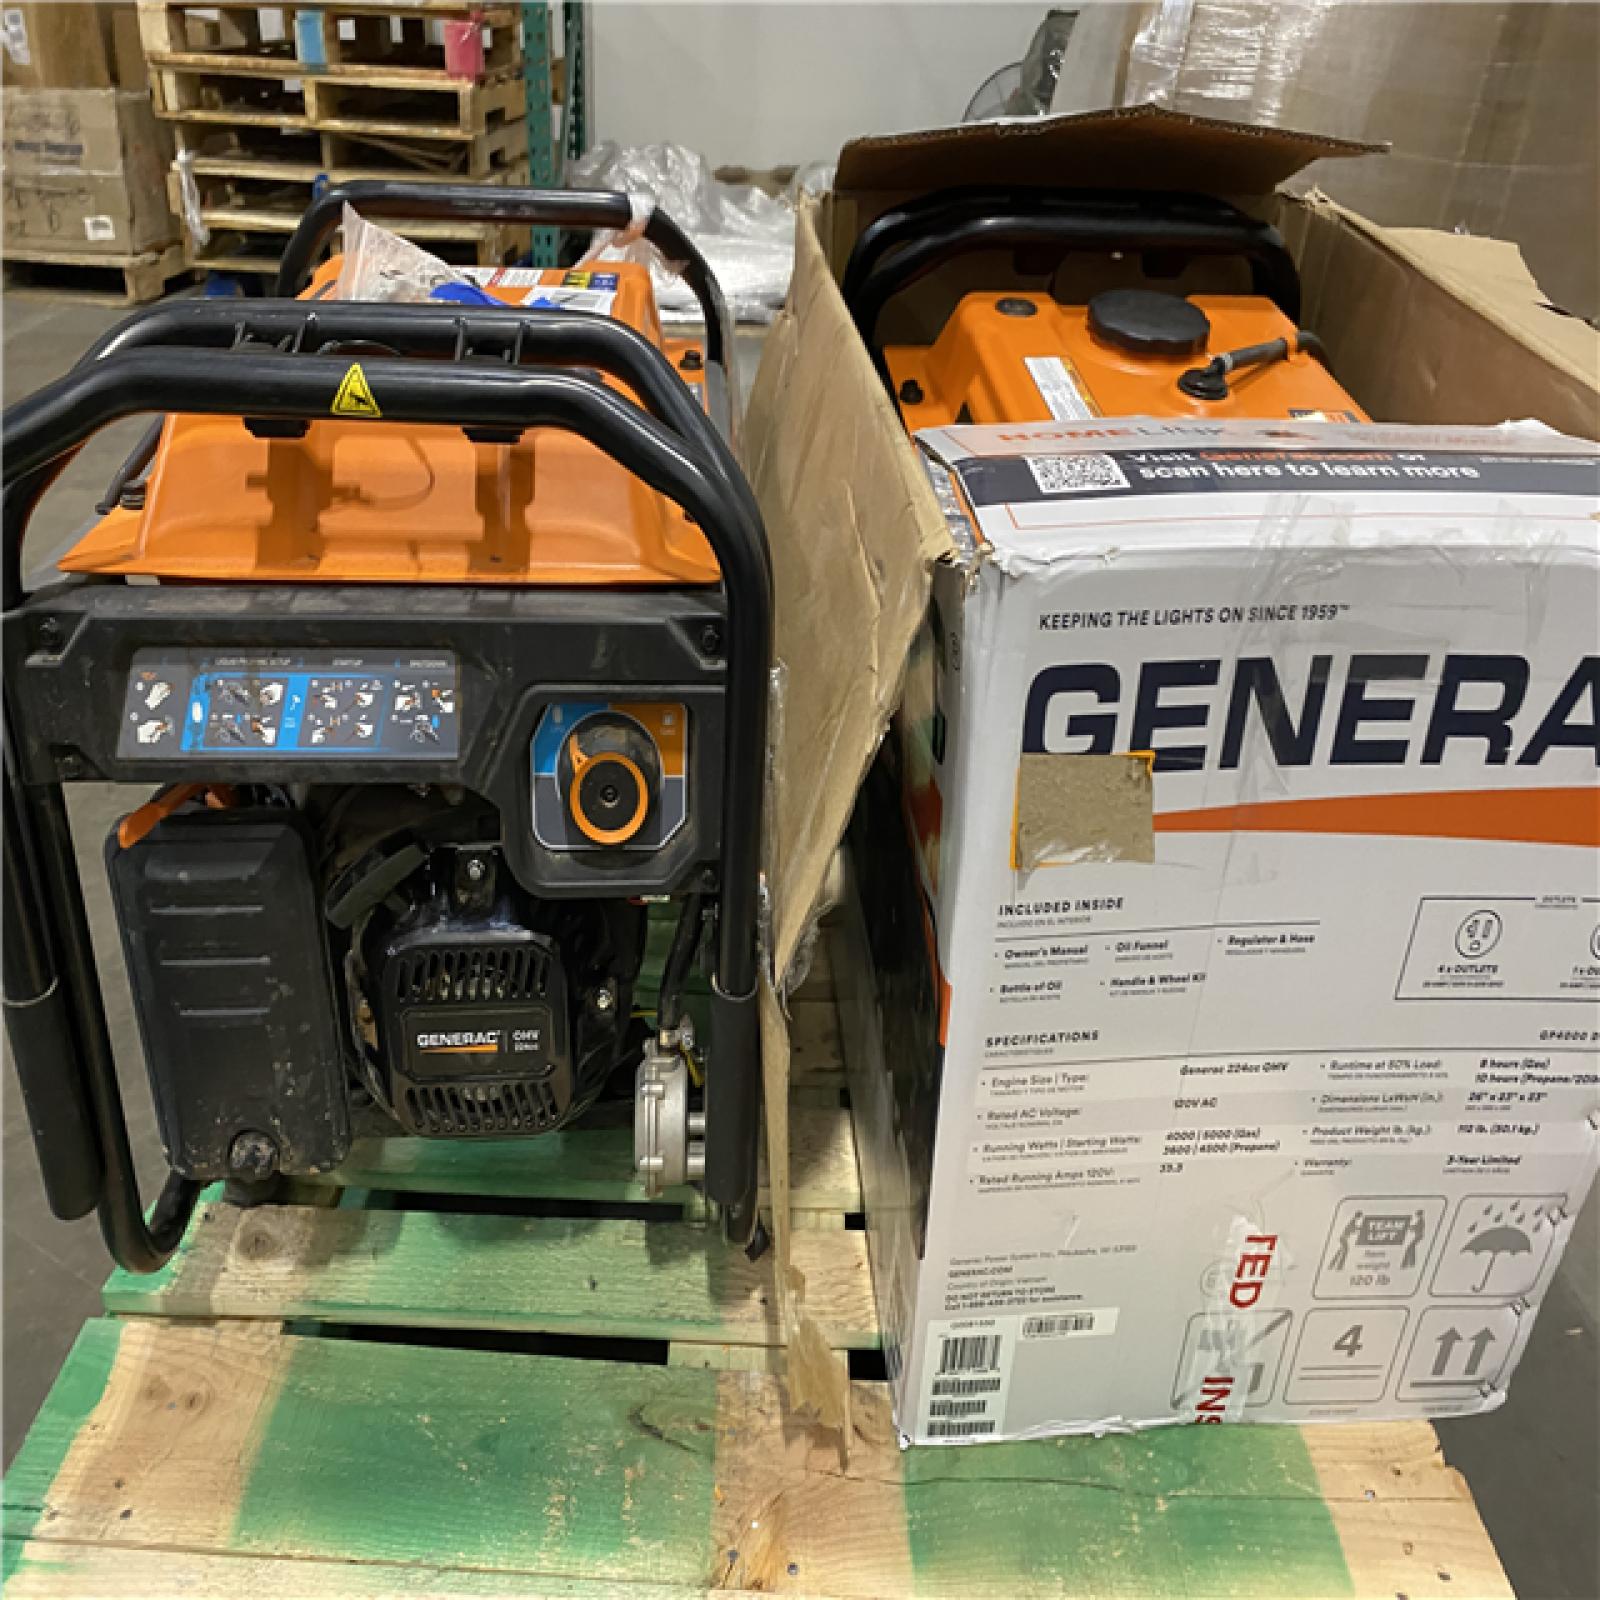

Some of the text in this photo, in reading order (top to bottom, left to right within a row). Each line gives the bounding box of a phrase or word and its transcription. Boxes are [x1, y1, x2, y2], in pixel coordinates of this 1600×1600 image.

[1139, 462, 1481, 479] scan here to learn more
[1039, 610, 1113, 631] KEEPING
[1117, 609, 1150, 626] THE
[1153, 607, 1214, 626] LIGHTS
[1219, 606, 1243, 623] ON
[1248, 604, 1298, 622] SINCE
[998, 897, 1124, 916] INCLUDED INSIDE
[1116, 939, 1169, 952] Oil Funnel
[1228, 934, 1278, 948] Regulator
[1289, 933, 1316, 944] Hose
[1004, 944, 1088, 960] Owner's Manual
[1000, 980, 1063, 994] Bottle of Oil
[1110, 976, 1146, 988] Handle
[1159, 972, 1190, 984] Wheel
[1192, 972, 1206, 983] Kit
[417, 1031, 499, 1046] GENERAC
[984, 1030, 1099, 1048] SPECIFICATIONS
[1180, 1064, 1224, 1076] Generac
[1262, 1062, 1289, 1073] OHV
[1330, 1060, 1373, 1070] Runtime
[1489, 1059, 1519, 1069] hours
[1521, 1057, 1551, 1070] (Gas)
[991, 1075, 1028, 1089] Engine
[1030, 1074, 1053, 1085] Size
[1489, 1074, 1519, 1084] hours
[1200, 1097, 1218, 1108] AC
[1321, 1094, 1380, 1104] Dimensions
[986, 1110, 1018, 1121] Rated
[1020, 1107, 1036, 1119] AC
[1165, 1131, 1196, 1142] 4000
[1233, 1128, 1261, 1140] (Gas)
[1312, 1126, 1350, 1136] Product
[1353, 1125, 1391, 1135] Weight
[982, 1142, 1026, 1154] Running
[1028, 1140, 1058, 1152] Watts
[1066, 1137, 1107, 1149] Starting
[1229, 1140, 1281, 1154] (Propane)
[1482, 1154, 1522, 1166] Limited
[979, 1174, 1011, 1185] Rated
[1012, 1172, 1053, 1185] Running
[1054, 1169, 1084, 1181] Amps
[1368, 1219, 1406, 1231] TEAM
[1367, 1231, 1398, 1242] LIFT
[1349, 1273, 1390, 1286] 120 lb
[1332, 1323, 1364, 1358] 4
